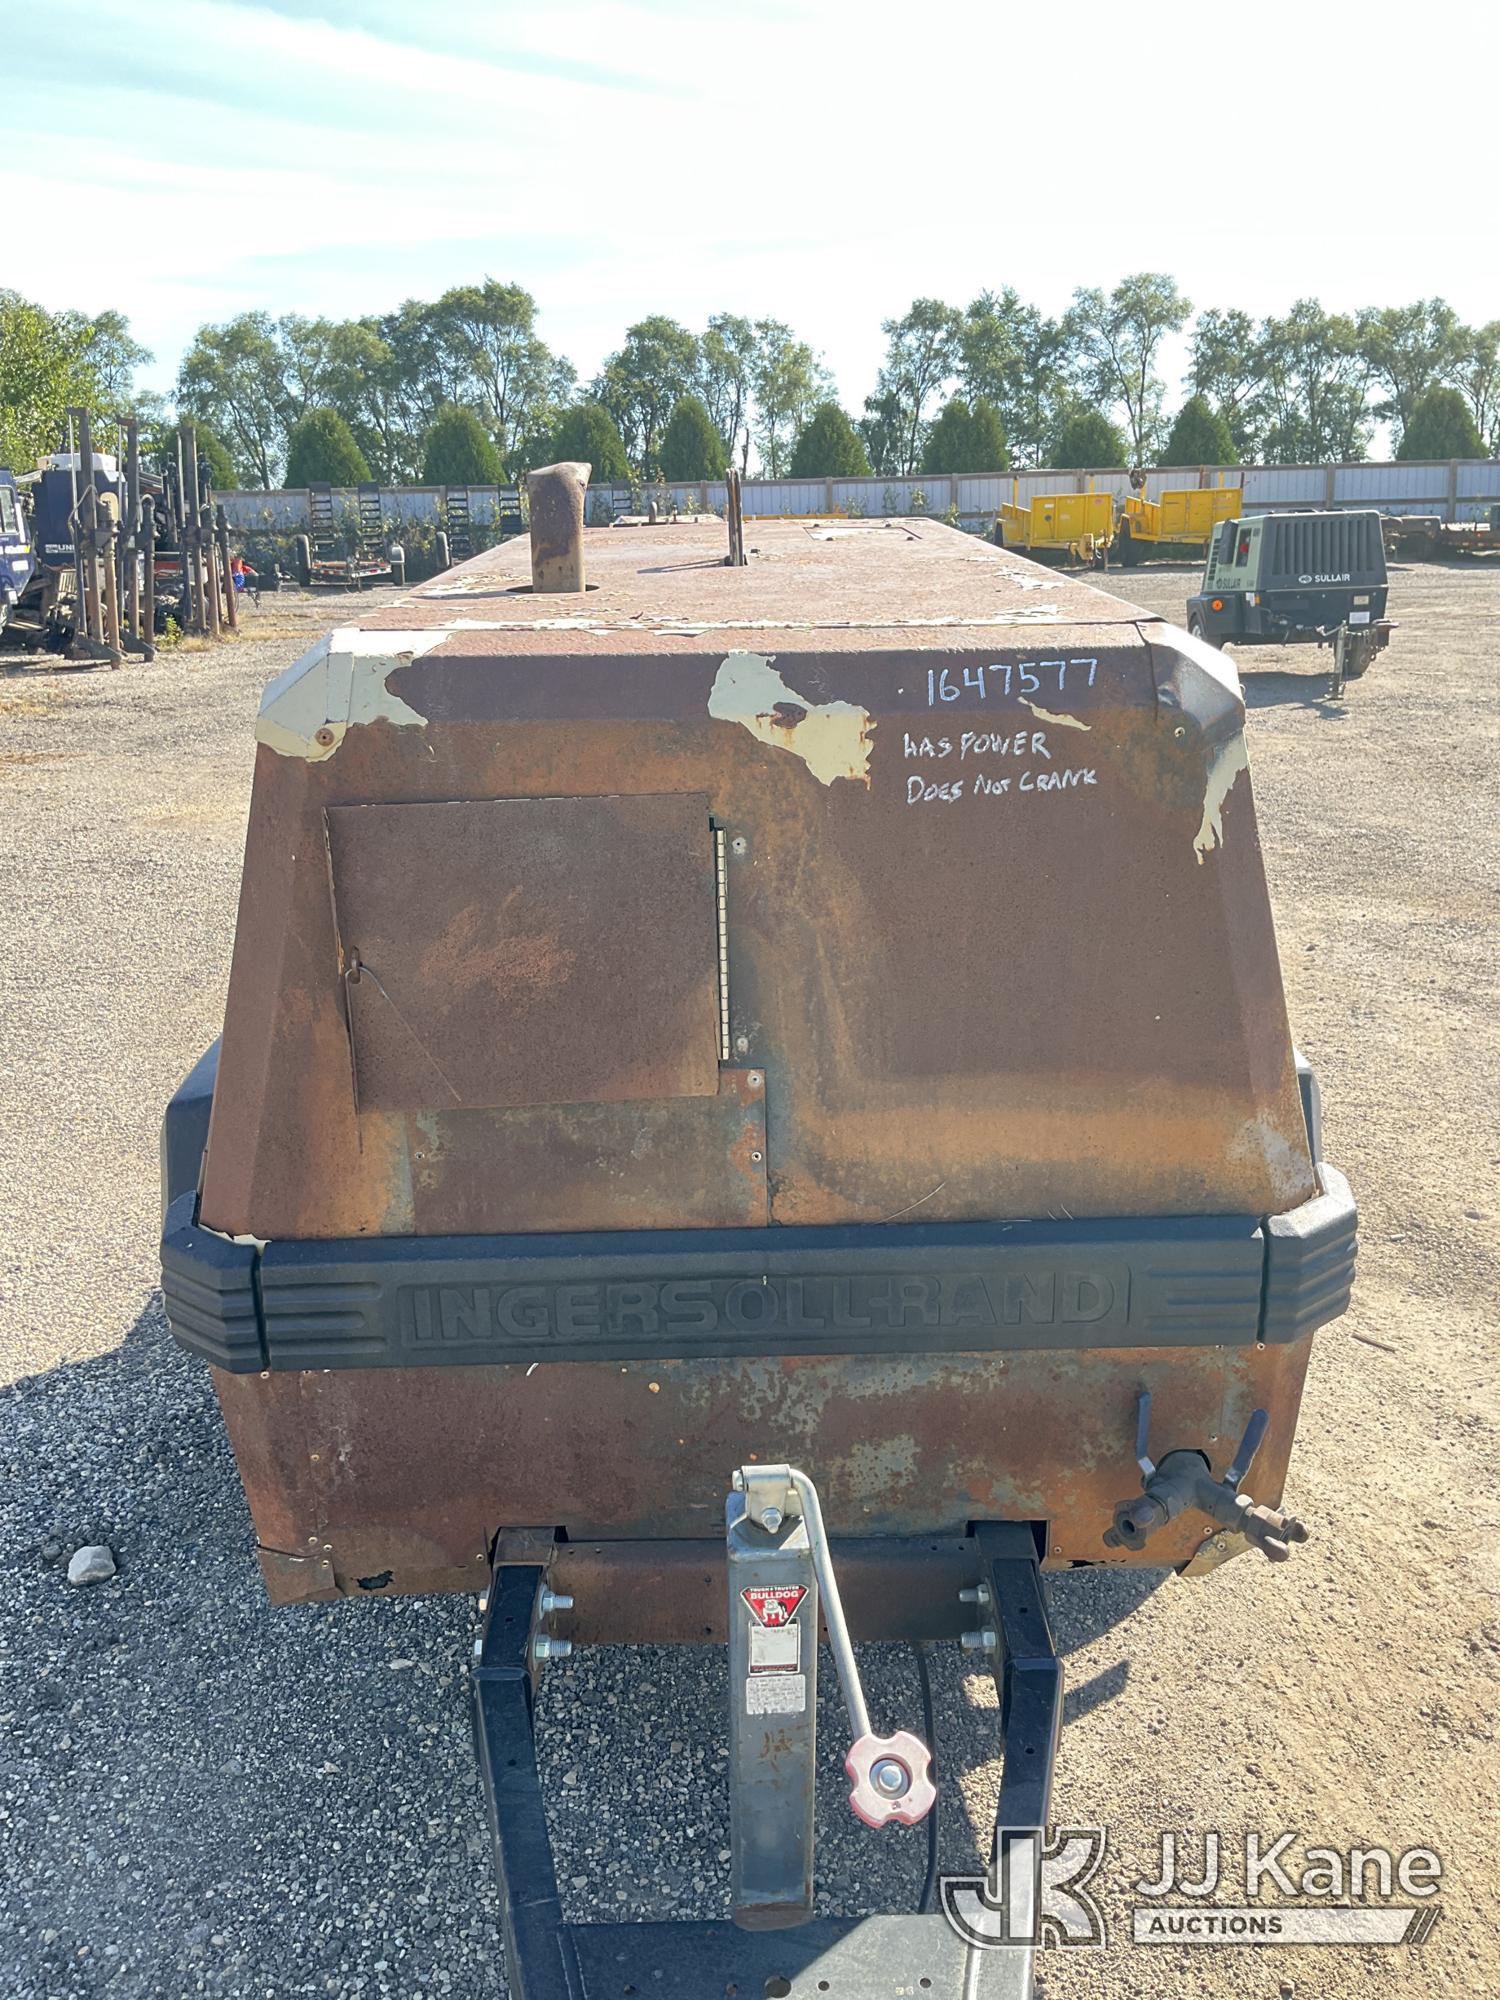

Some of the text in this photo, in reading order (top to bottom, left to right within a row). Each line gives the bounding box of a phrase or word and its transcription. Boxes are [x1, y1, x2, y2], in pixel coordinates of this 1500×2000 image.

[1314, 573, 1351, 583] SULLAIR
[927, 658, 1098, 706] 1647577
[960, 731, 1051, 760] POWER
[1018, 767, 1098, 792] CRANK
[750, 1590, 799, 1600] BULLDOG
